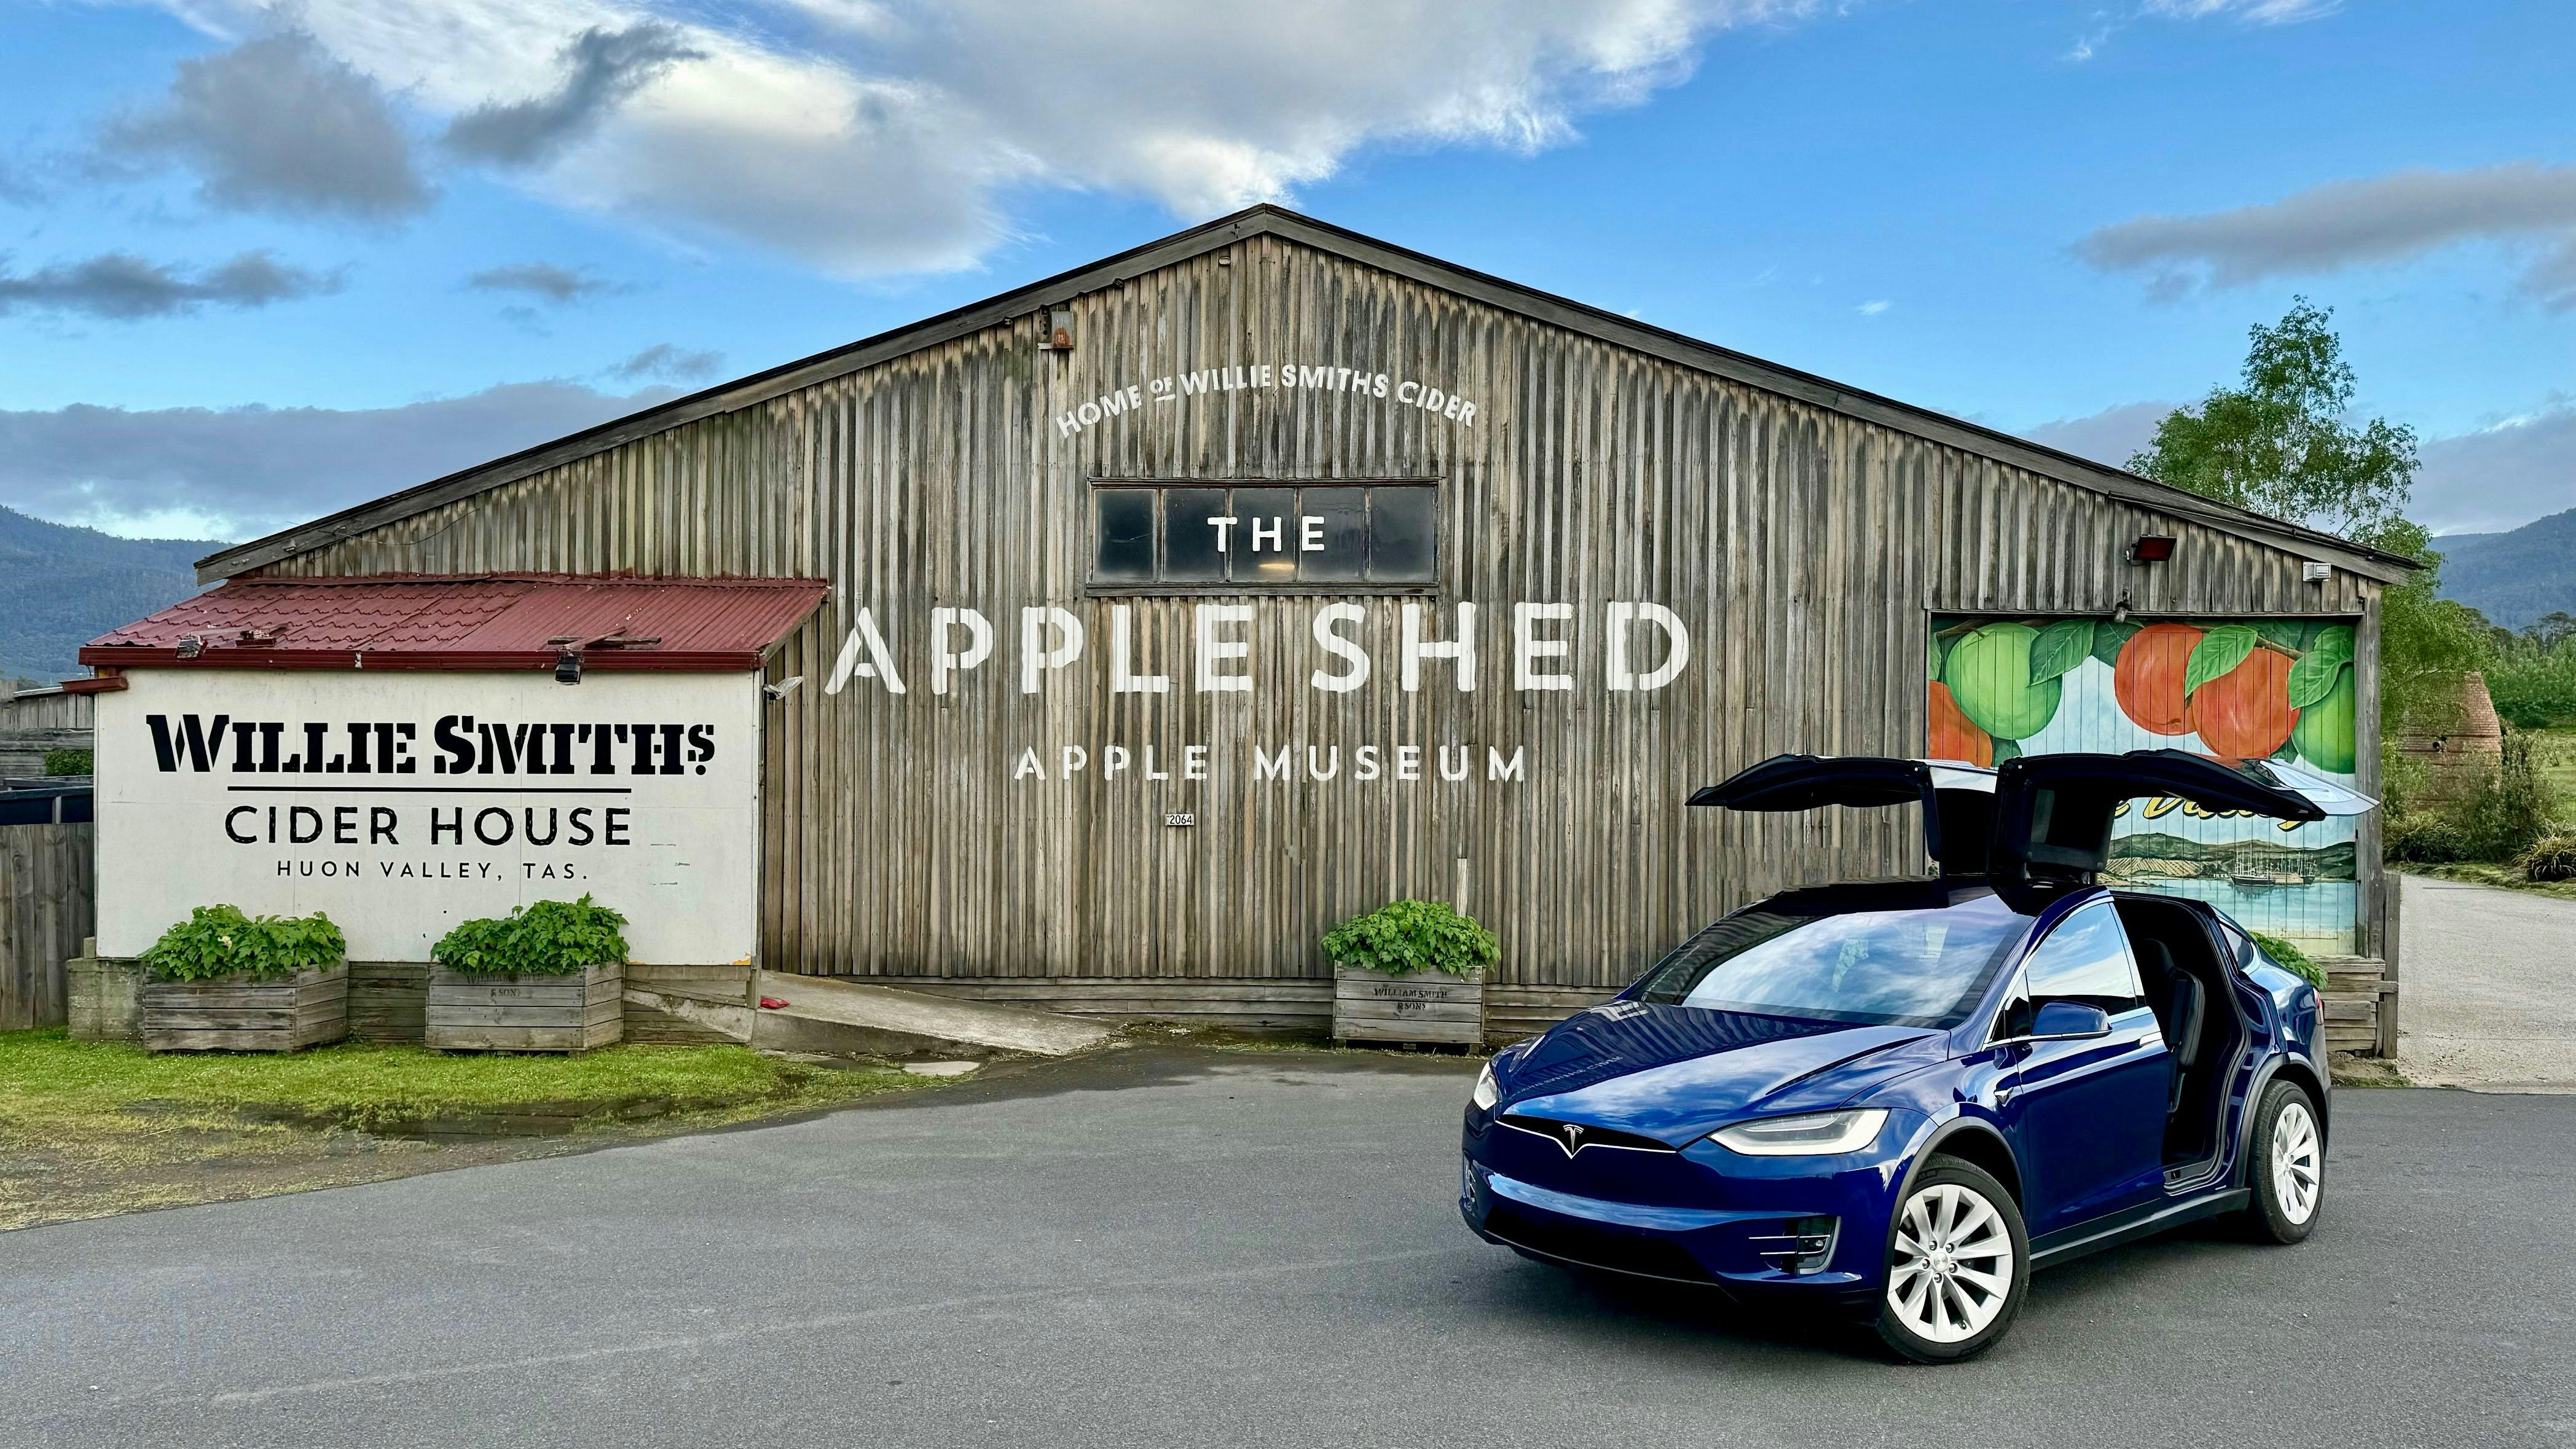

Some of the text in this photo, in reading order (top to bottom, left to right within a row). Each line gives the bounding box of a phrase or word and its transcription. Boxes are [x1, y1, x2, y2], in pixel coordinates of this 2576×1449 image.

[1056, 364, 1476, 438] HOME OF WILLIE SMITHS CIDER
[1207, 516, 1325, 552] THE
[825, 602, 1689, 695] APPLE SHED
[146, 714, 715, 776] WILLIE SMITHS
[1014, 745, 1524, 783] APPLE MUSEUM
[225, 805, 630, 846] CIDER HOUSE
[1169, 815, 1192, 824] 2064
[277, 860, 587, 881] HUON VALLEY, TAS.
